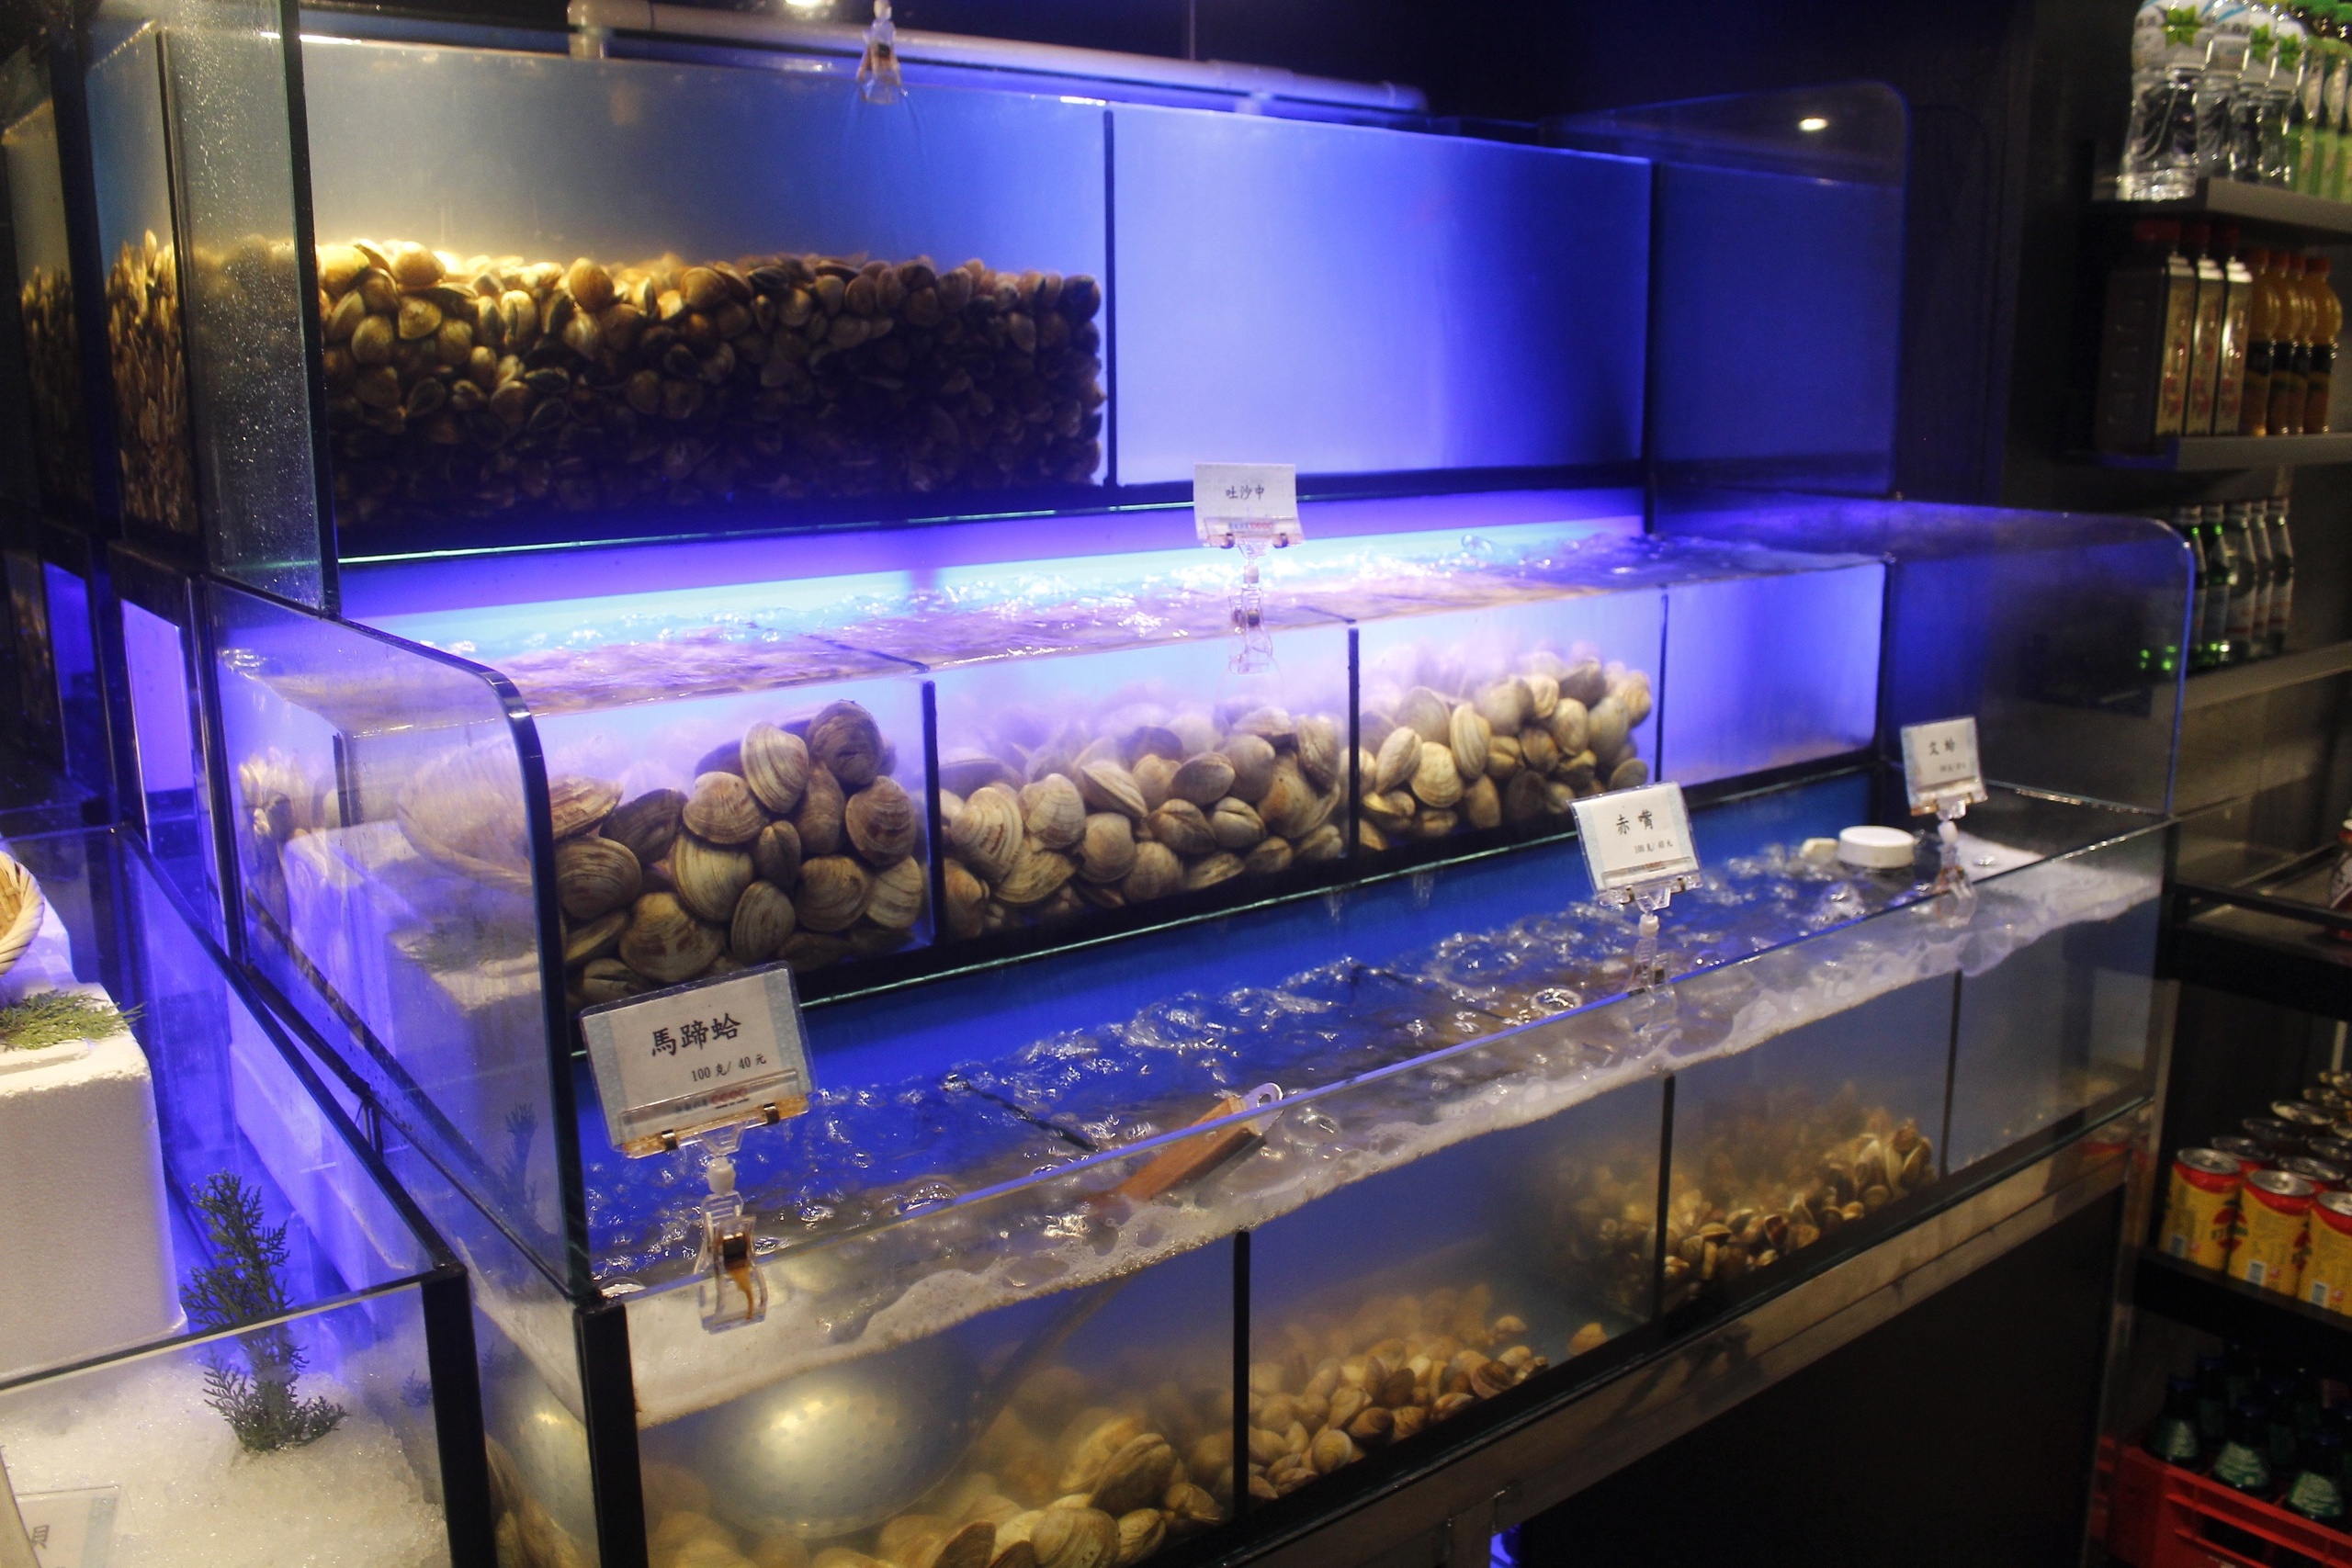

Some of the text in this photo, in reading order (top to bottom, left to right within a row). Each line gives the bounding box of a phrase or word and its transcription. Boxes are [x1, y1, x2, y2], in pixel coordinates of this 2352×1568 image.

[1226, 484, 1265, 501] 吐沙中
[651, 1012, 742, 1056] 馬蹄蛤
[691, 1054, 767, 1082] 100 克/ 40 元
